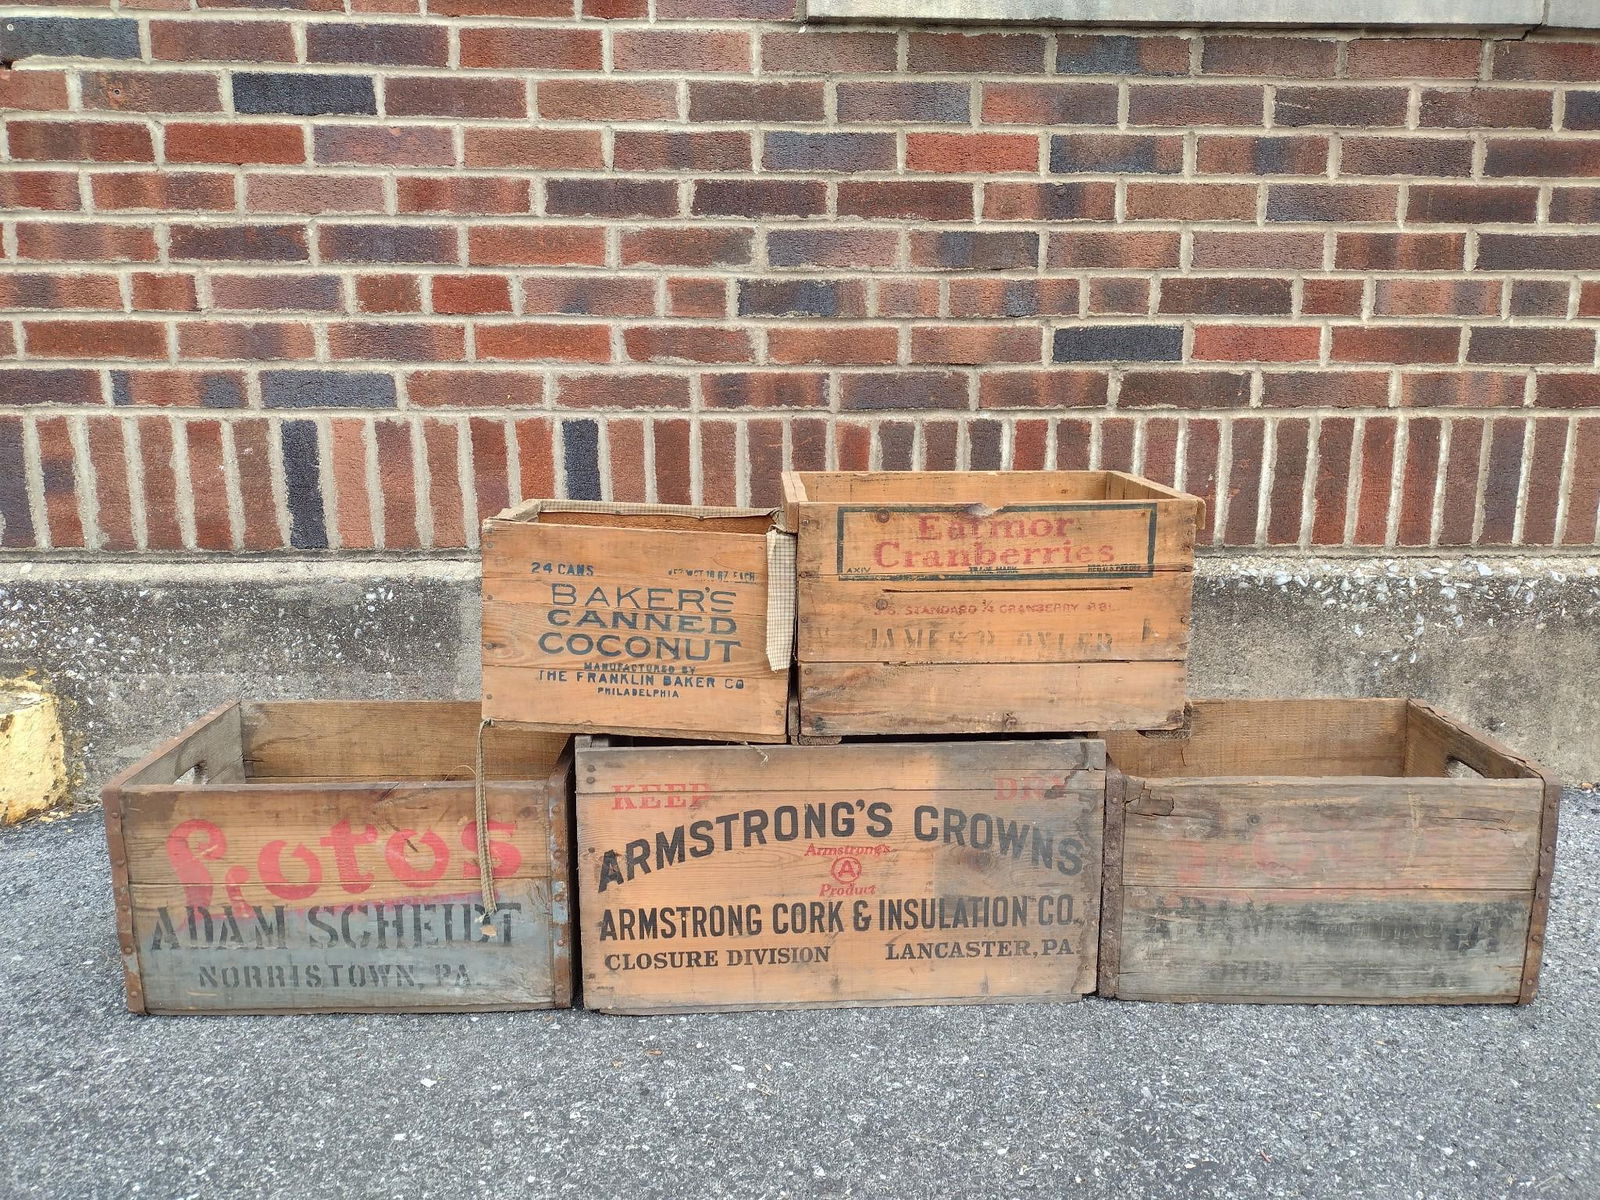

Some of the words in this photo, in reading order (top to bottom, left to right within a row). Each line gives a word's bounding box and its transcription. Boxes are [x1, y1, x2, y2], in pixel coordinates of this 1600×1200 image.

[915, 514, 1076, 541] Eatmor
[873, 540, 1116, 569] Cranberries
[531, 561, 553, 574] 24
[557, 563, 594, 577] CANS
[551, 582, 738, 613] BAKER'S
[905, 604, 977, 616] STANDARD
[547, 608, 738, 636] CANNED
[538, 631, 742, 663] COCONUT
[538, 670, 567, 682] THE
[576, 671, 655, 686] FRANKLIN
[663, 675, 715, 688] BAKER
[584, 662, 675, 674] MANUFACTURED
[682, 666, 696, 675] BY
[597, 686, 679, 699] PHILADELPHIA
[611, 783, 711, 811] KEEP
[597, 799, 893, 893] ARMSTRONG'S
[914, 805, 1083, 876] CROWNS
[804, 842, 891, 857] Armstrong's
[819, 882, 876, 897] Product
[150, 904, 289, 951] ADAM
[308, 902, 522, 950] SCHEIDT
[600, 904, 762, 941] ARMSTRONG
[772, 900, 845, 935] CORK
[852, 899, 872, 932] &
[879, 894, 1028, 931] INSULATION
[604, 950, 719, 971] CLOSURE
[726, 946, 831, 967] DIVISION
